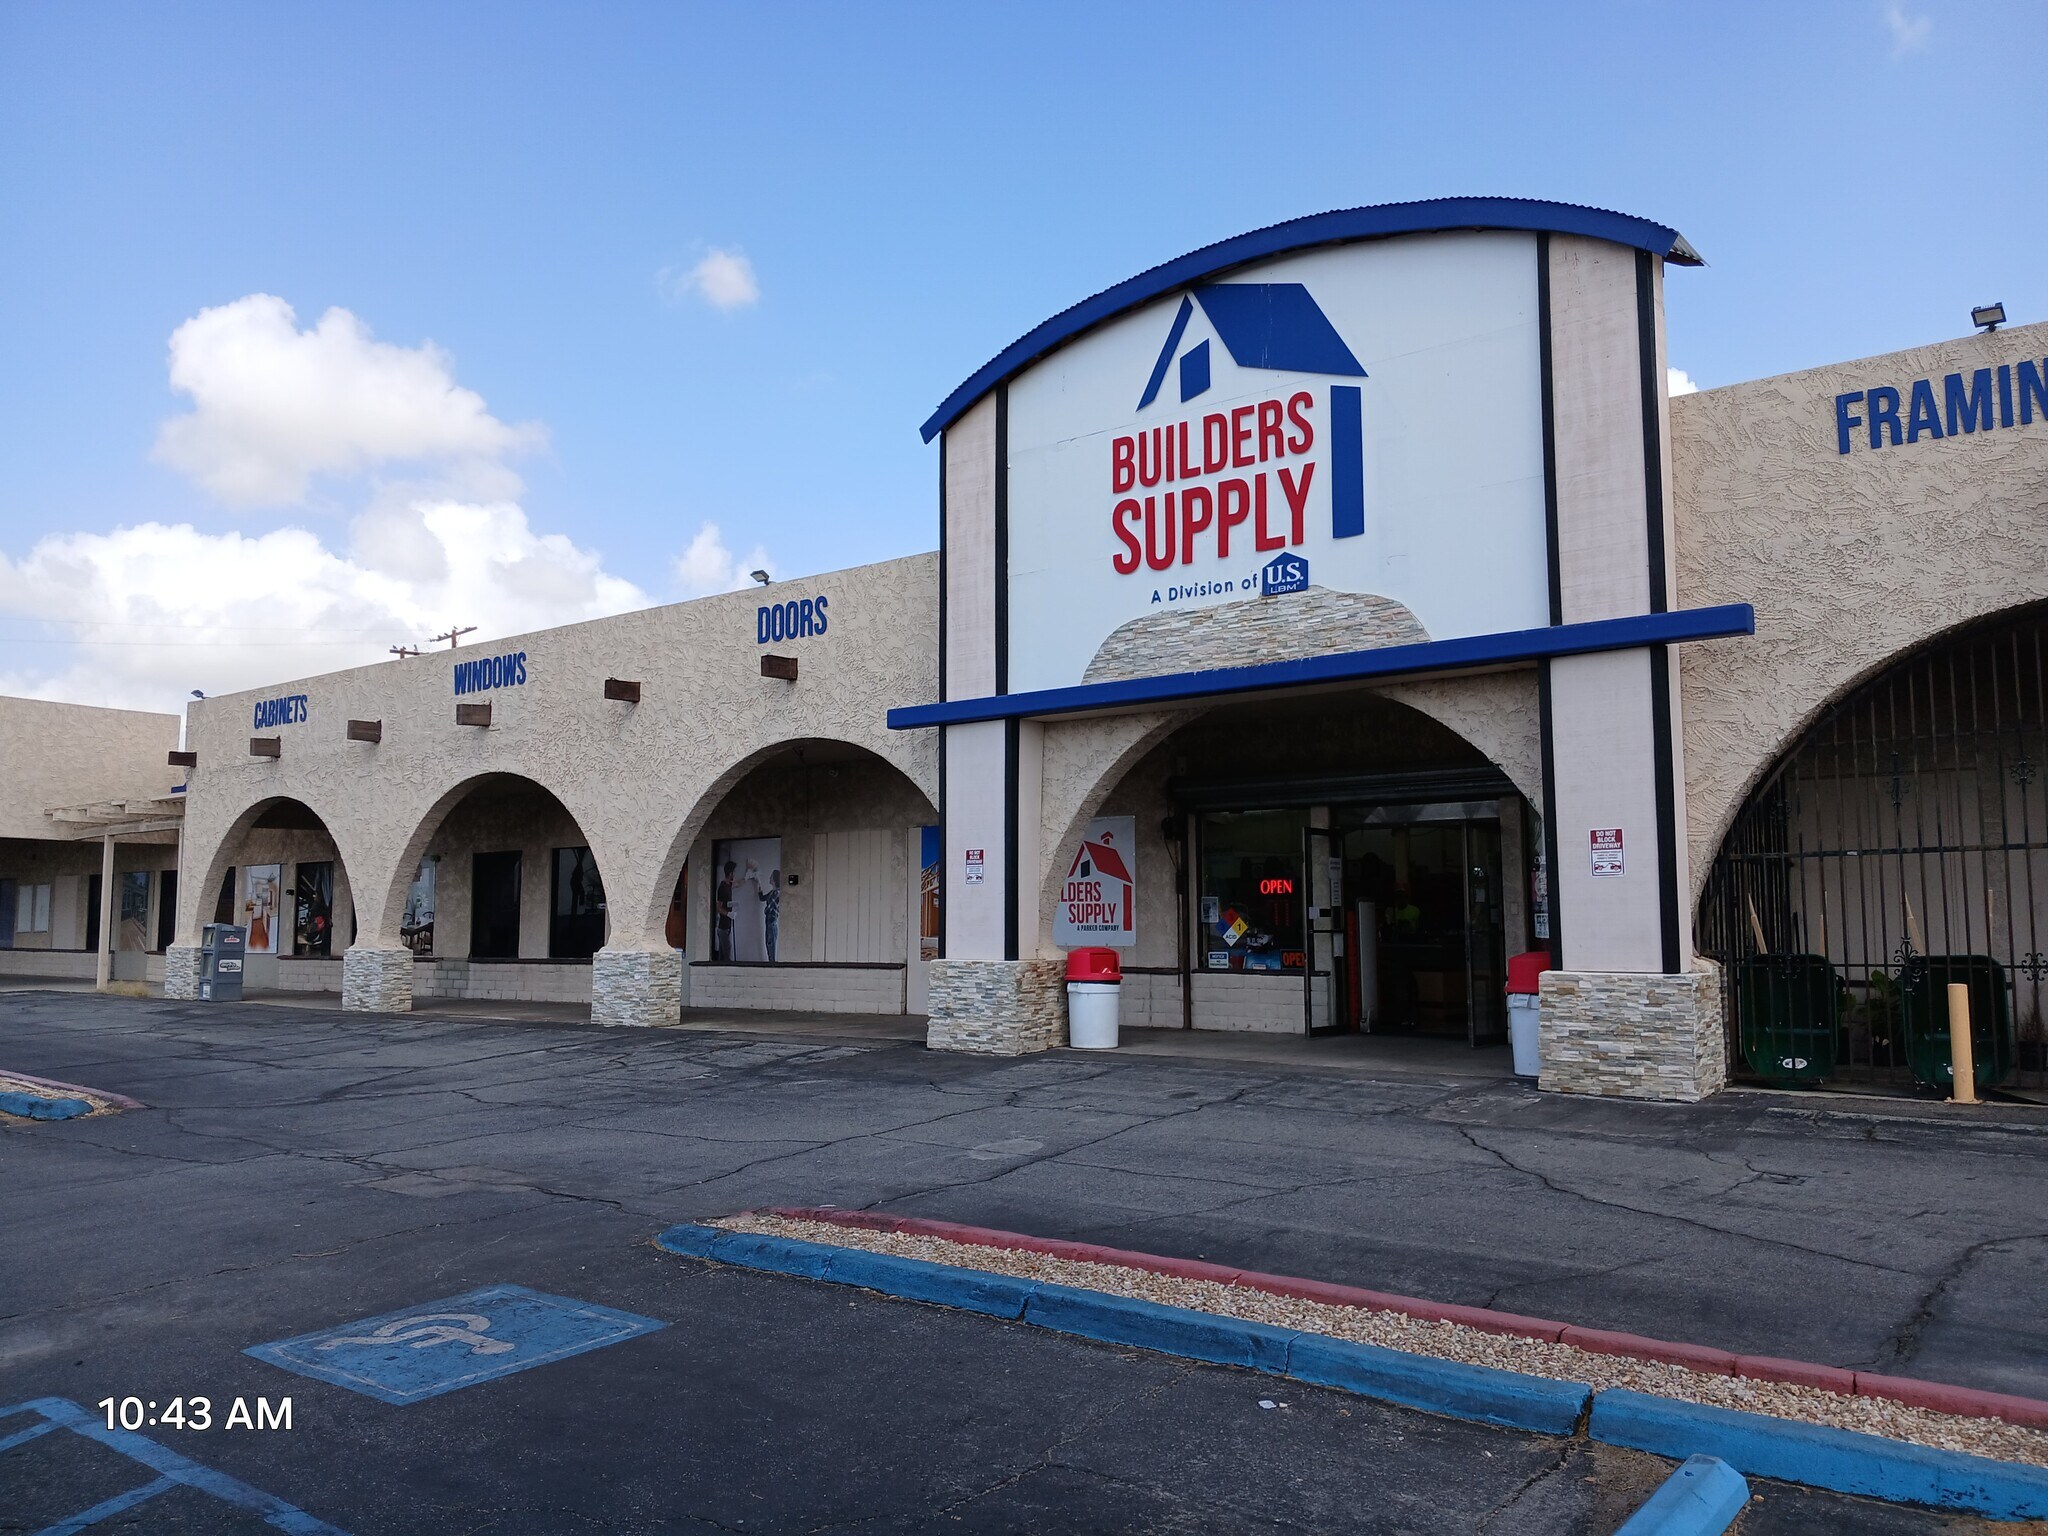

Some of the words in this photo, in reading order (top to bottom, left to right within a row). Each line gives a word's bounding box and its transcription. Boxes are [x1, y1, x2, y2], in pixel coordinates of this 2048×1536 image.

[1112, 390, 1314, 494] BUILDERS
[1112, 461, 1316, 575] SUPPLY
[1266, 561, 1304, 585] U.S.
[1150, 589, 1162, 604] A
[1168, 579, 1234, 602] Division
[1241, 573, 1258, 590] of
[1270, 583, 1298, 594] LBM
[757, 595, 829, 645] DOORS
[454, 651, 527, 696] WINDOWS
[254, 694, 308, 730] CABINETS
[1592, 842, 1621, 850] DRIVEWAY
[1260, 879, 1292, 895] OPEN
[1068, 903, 1117, 924] SUPPLY
[1076, 924, 1080, 932] A
[1080, 924, 1098, 932] PARKER
[1098, 924, 1120, 932] COMPANY
[1237, 923, 1241, 931] 1
